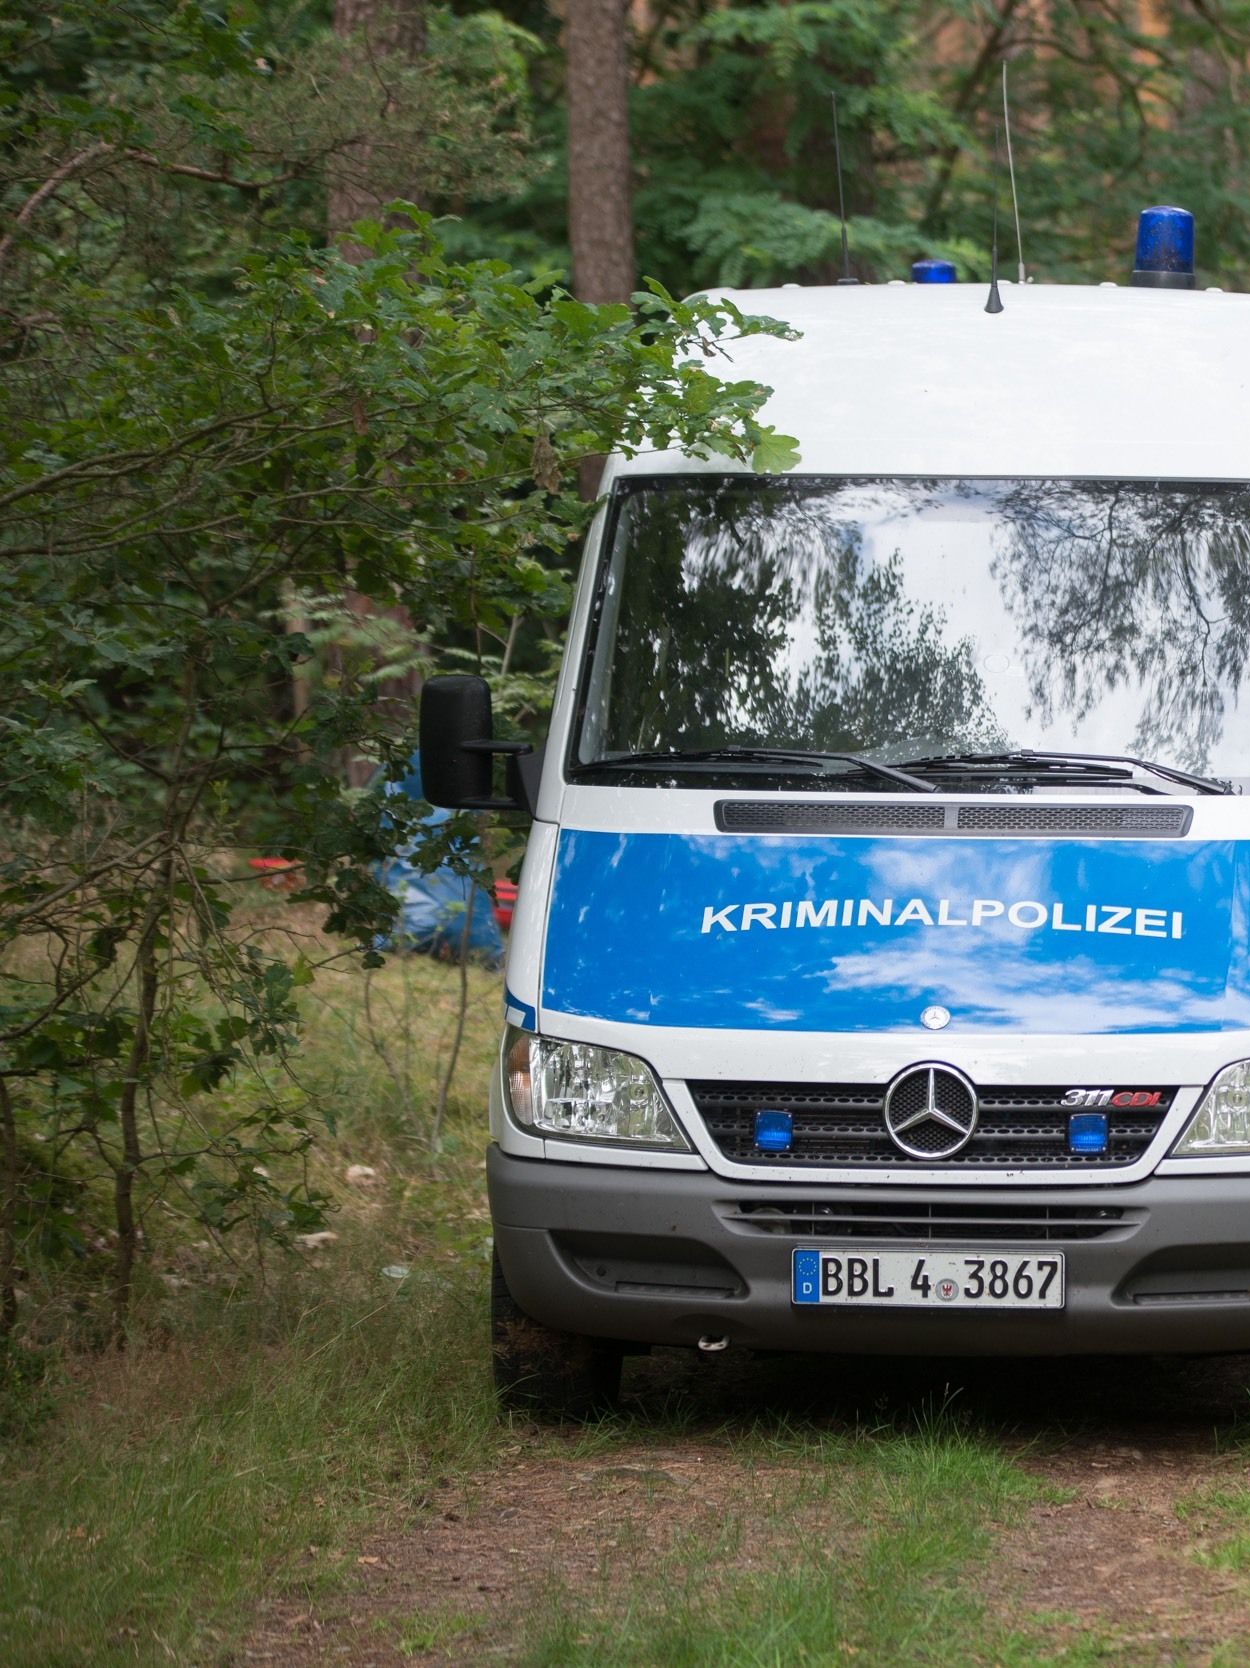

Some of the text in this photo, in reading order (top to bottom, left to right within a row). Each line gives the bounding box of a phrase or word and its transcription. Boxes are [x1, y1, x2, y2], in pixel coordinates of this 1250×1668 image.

[701, 898, 1183, 940] KRIMINALPOLIZEI
[802, 1256, 1059, 1300] D BBL 4 3867
